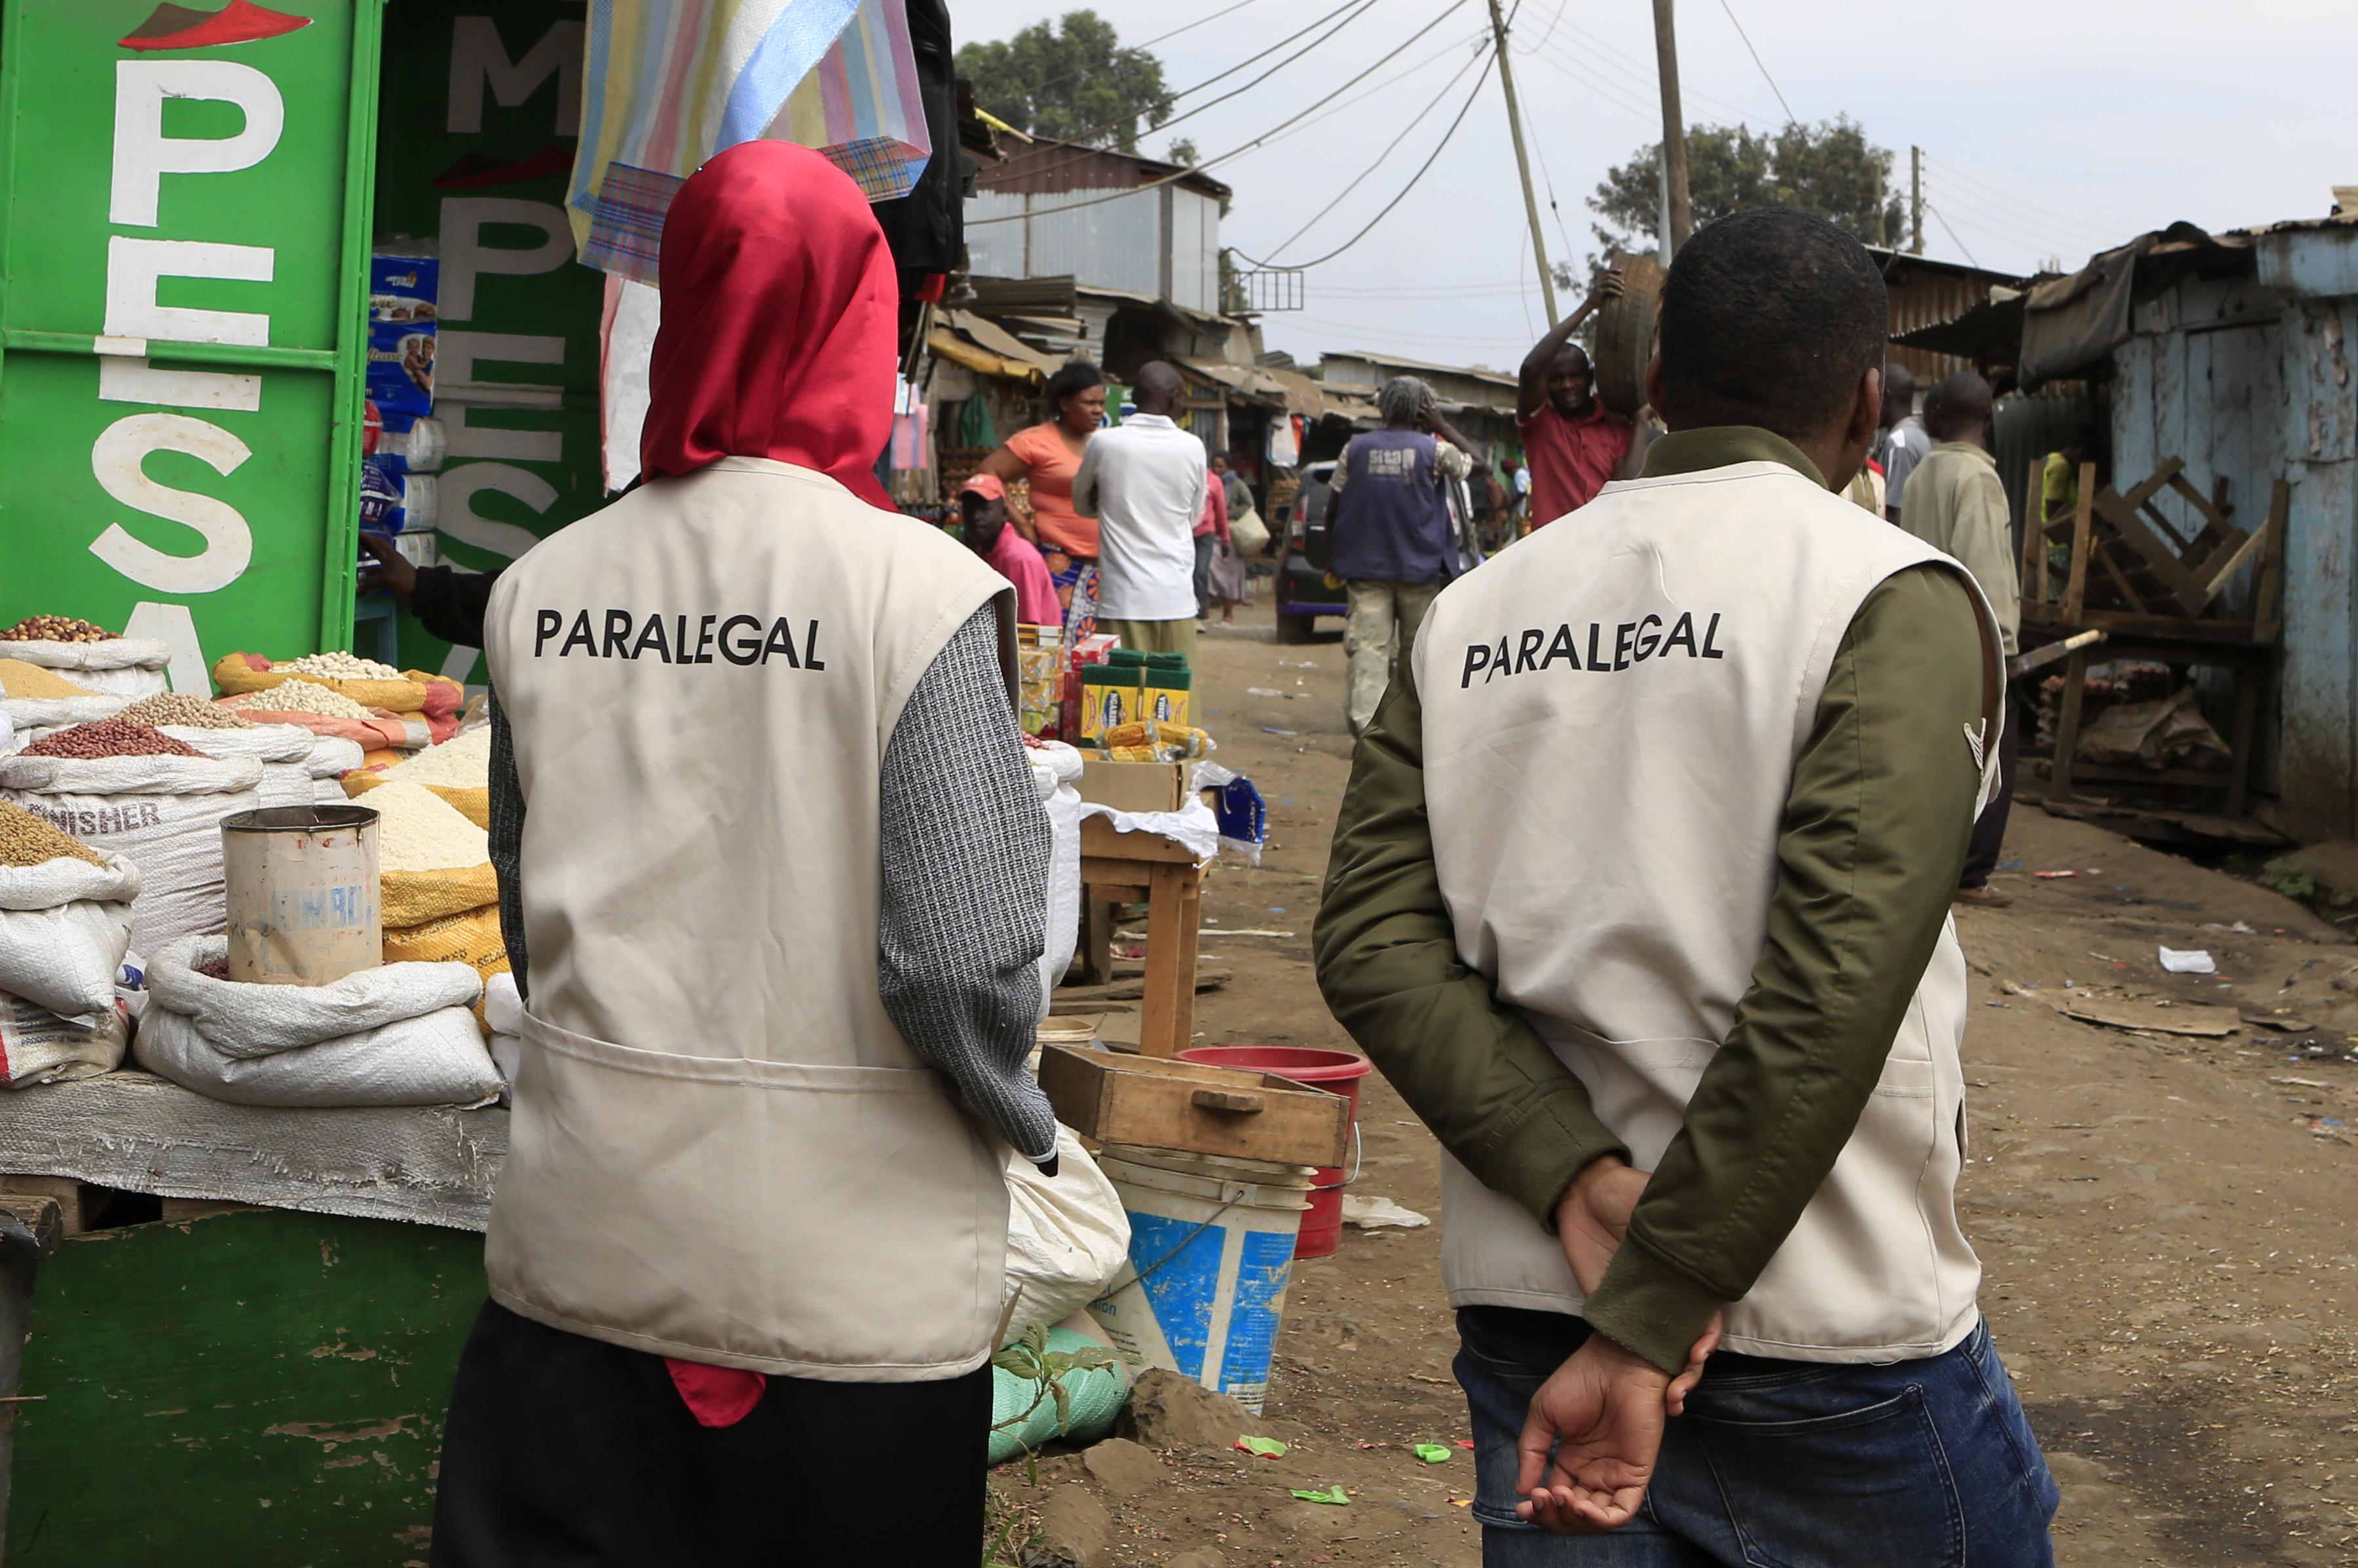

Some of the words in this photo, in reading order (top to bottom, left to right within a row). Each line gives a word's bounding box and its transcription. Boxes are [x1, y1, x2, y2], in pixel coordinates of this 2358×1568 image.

[447, 16, 585, 136] M
[534, 608, 825, 671] PARALEGAL
[1460, 611, 1724, 689] PARALEGAL
